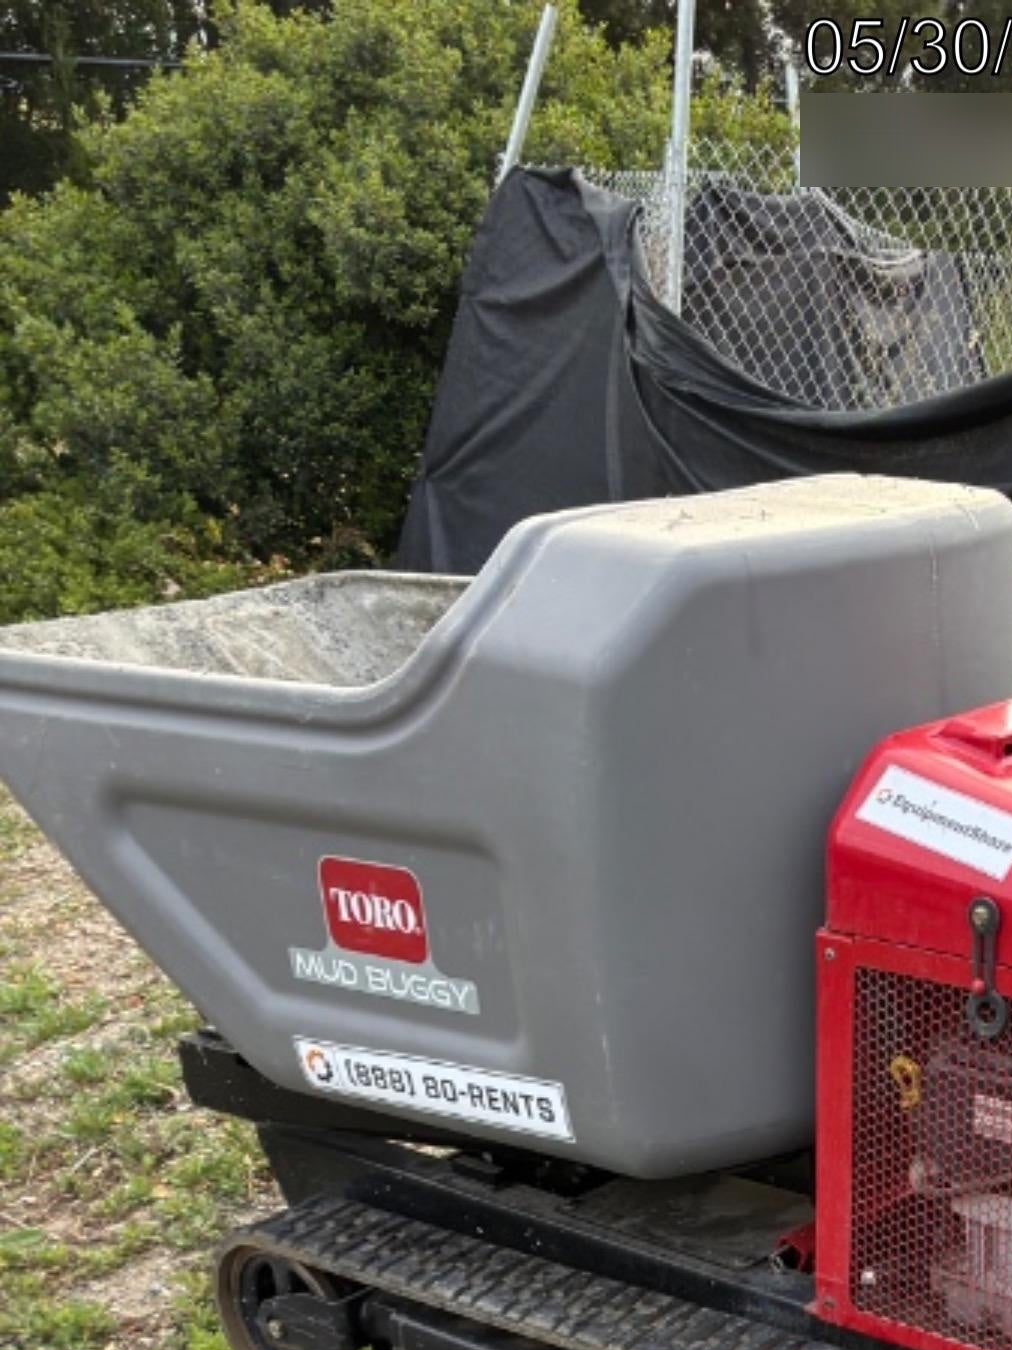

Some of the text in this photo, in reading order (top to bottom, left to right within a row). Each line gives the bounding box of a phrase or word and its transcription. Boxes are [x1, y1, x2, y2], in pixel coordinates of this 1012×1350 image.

[295, 953, 470, 1008] MUD BUGGY
[344, 1057, 556, 1123] (888) 80-RENTS
